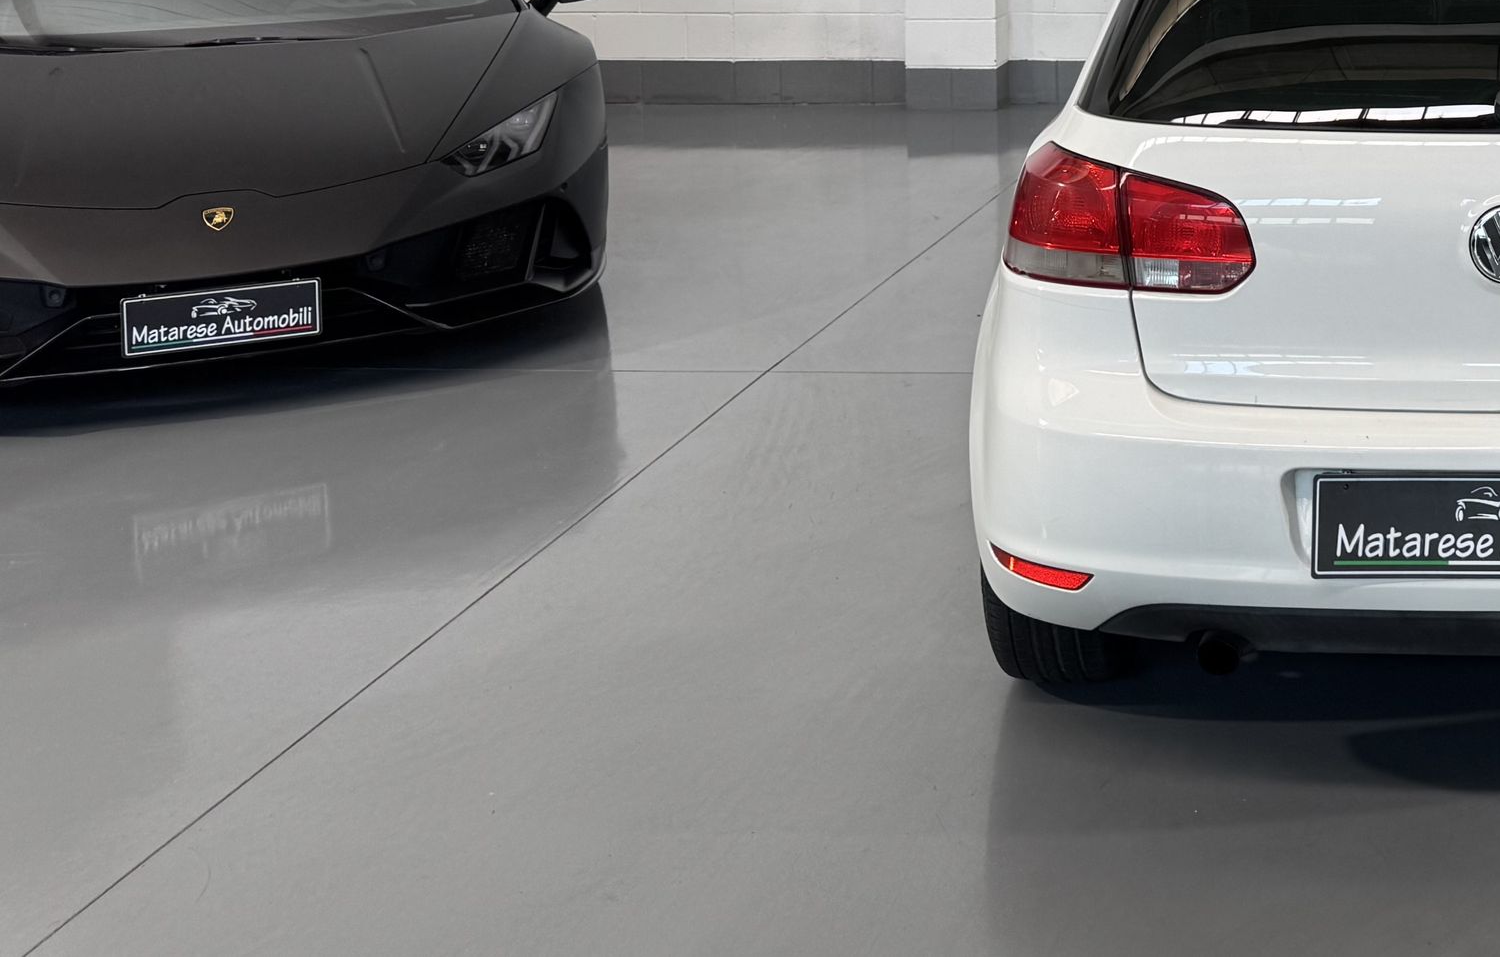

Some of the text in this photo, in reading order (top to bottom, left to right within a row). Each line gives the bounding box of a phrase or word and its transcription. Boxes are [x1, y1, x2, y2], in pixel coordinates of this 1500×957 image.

[132, 306, 312, 345] Matarese Automobili
[1336, 523, 1494, 559] Matarese
